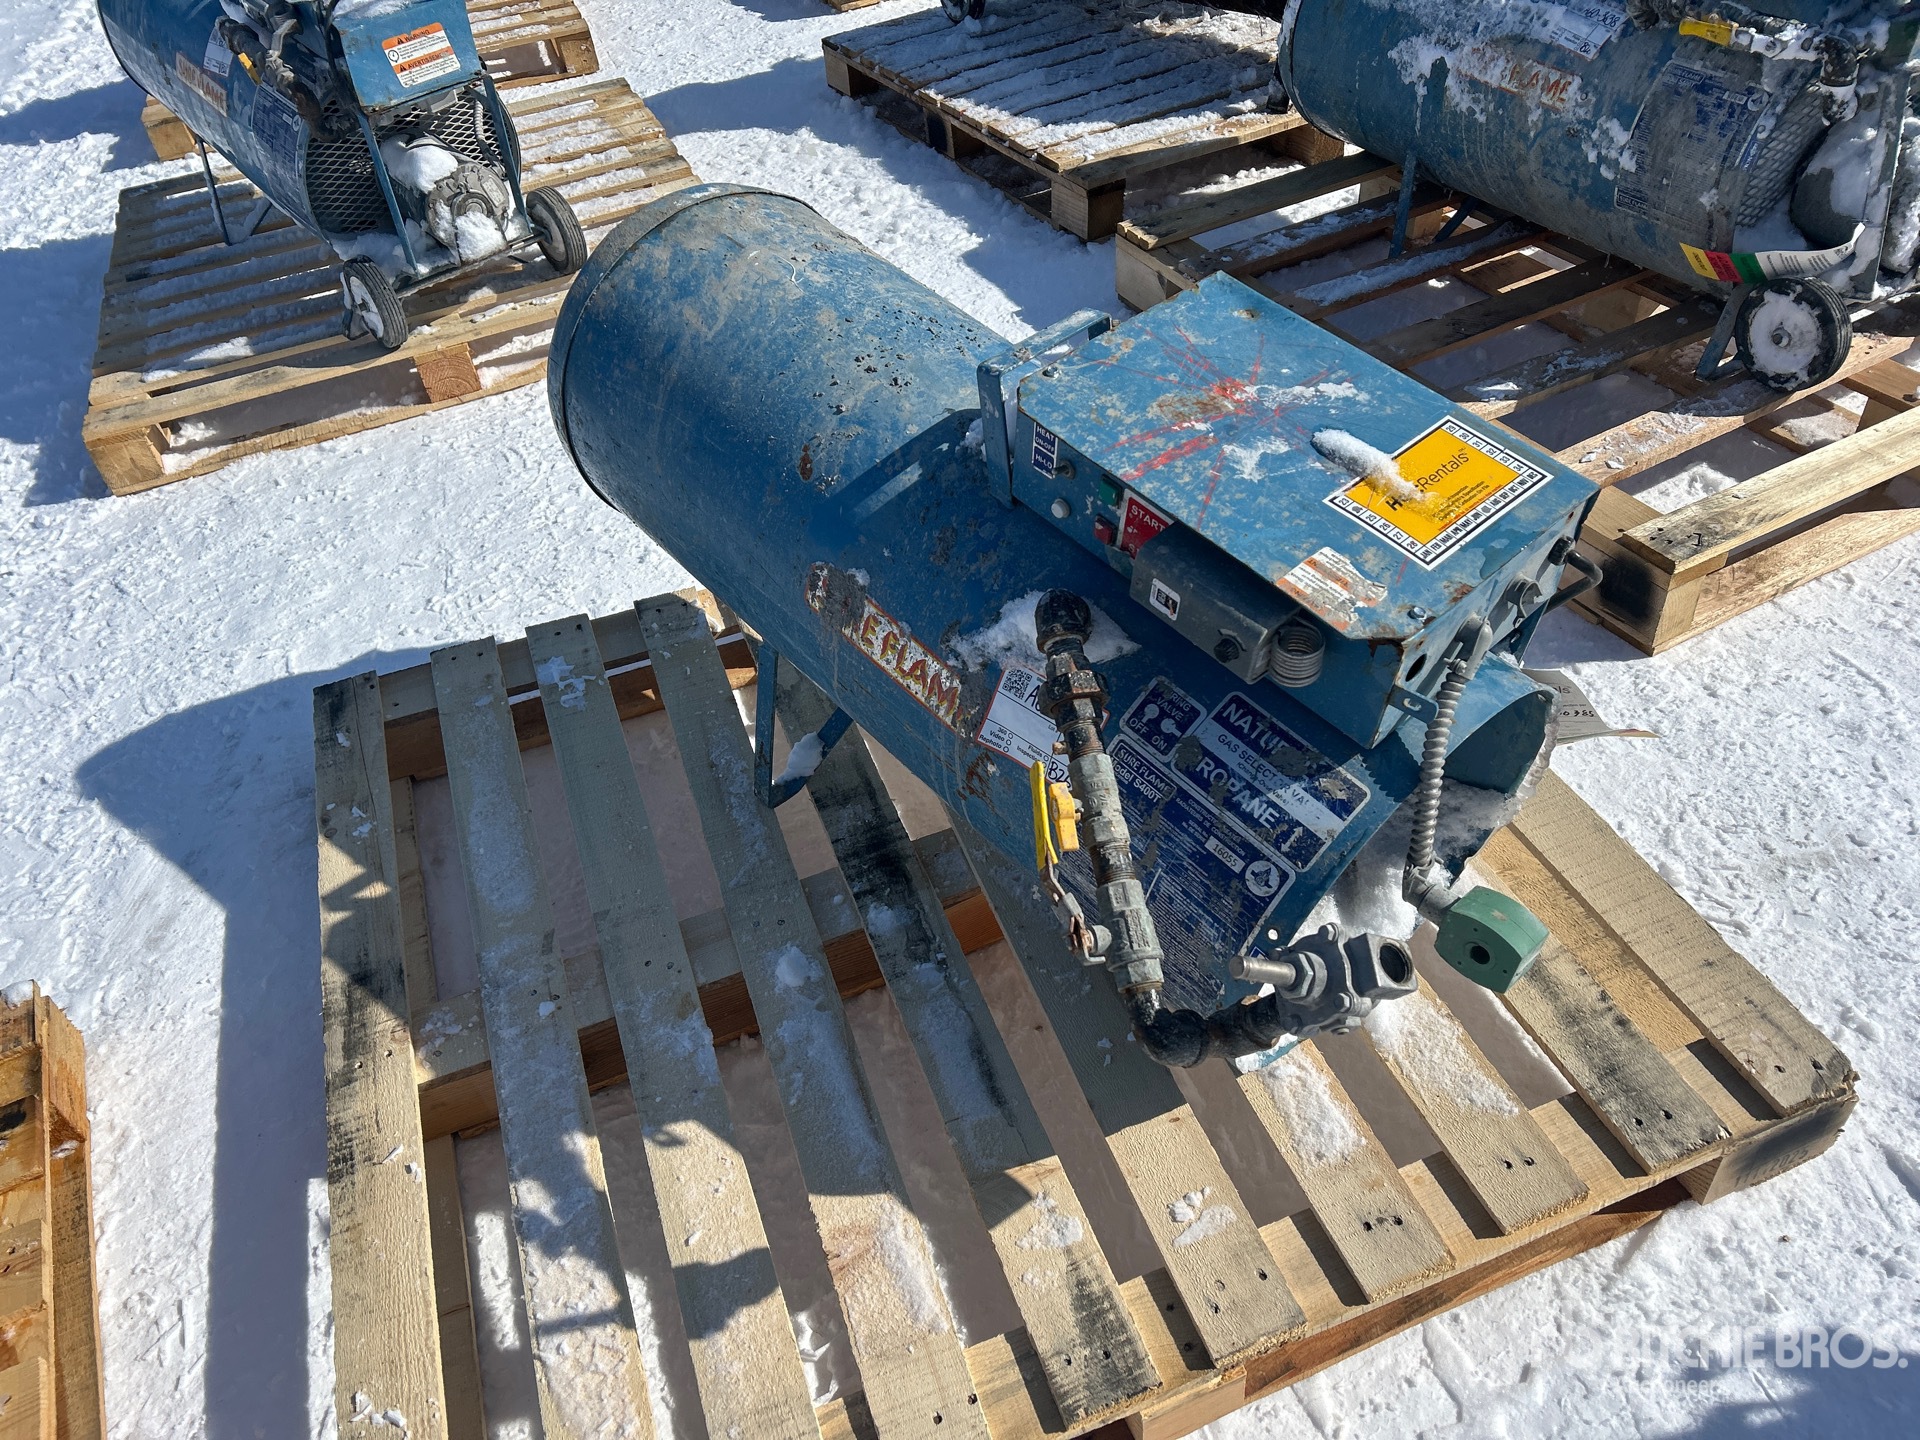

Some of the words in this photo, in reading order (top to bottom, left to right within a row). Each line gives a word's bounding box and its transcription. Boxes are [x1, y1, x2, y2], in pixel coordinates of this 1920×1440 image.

[1036, 426, 1055, 442] HEAT
[1446, 424, 1456, 433] 29
[1459, 432, 1470, 440] 30
[1035, 436, 1056, 452] ON-OFF
[1486, 448, 1497, 456] 32
[1035, 453, 1052, 470] HI-LO
[1500, 455, 1510, 464] 33
[1513, 463, 1524, 472] 34
[1385, 452, 1470, 512] HRentals
[1517, 479, 1529, 487] NOV
[1508, 484, 1518, 494] OCT
[1499, 491, 1509, 500] SEP
[1338, 497, 1349, 506] 23
[1490, 498, 1501, 507] AUG
[1132, 504, 1166, 532] START
[1365, 514, 1377, 522] 25
[1460, 519, 1473, 528] MAY
[1379, 522, 1391, 531] 26
[1450, 526, 1462, 536] APR
[1393, 532, 1404, 540] 27
[1440, 533, 1452, 544] MAR
[1407, 540, 1418, 550] 28
[1430, 541, 1441, 551] FEB
[1420, 549, 1432, 559] JAN
[880, 630, 962, 720] FLAM
[1170, 692, 1192, 712] RING
[1156, 697, 1184, 721] VALVE
[1129, 718, 1149, 734] OFF
[990, 730, 1005, 741] Video
[979, 734, 1002, 749] Rephoto
[1151, 735, 1167, 750] ON
[1218, 734, 1239, 753] GAS
[1017, 746, 1037, 760] Inspecti
[1028, 745, 1042, 757] Fluids
[1118, 749, 1140, 770] SURE
[1139, 766, 1171, 796] FLAME
[1134, 778, 1161, 803] S400T
[1195, 756, 1280, 829] ROPANE
[1188, 799, 1218, 825] CONSTRUCTI
[1203, 820, 1211, 828] DE
[1211, 827, 1246, 857] CONSTRUCTION
[1212, 844, 1238, 867] 16055
